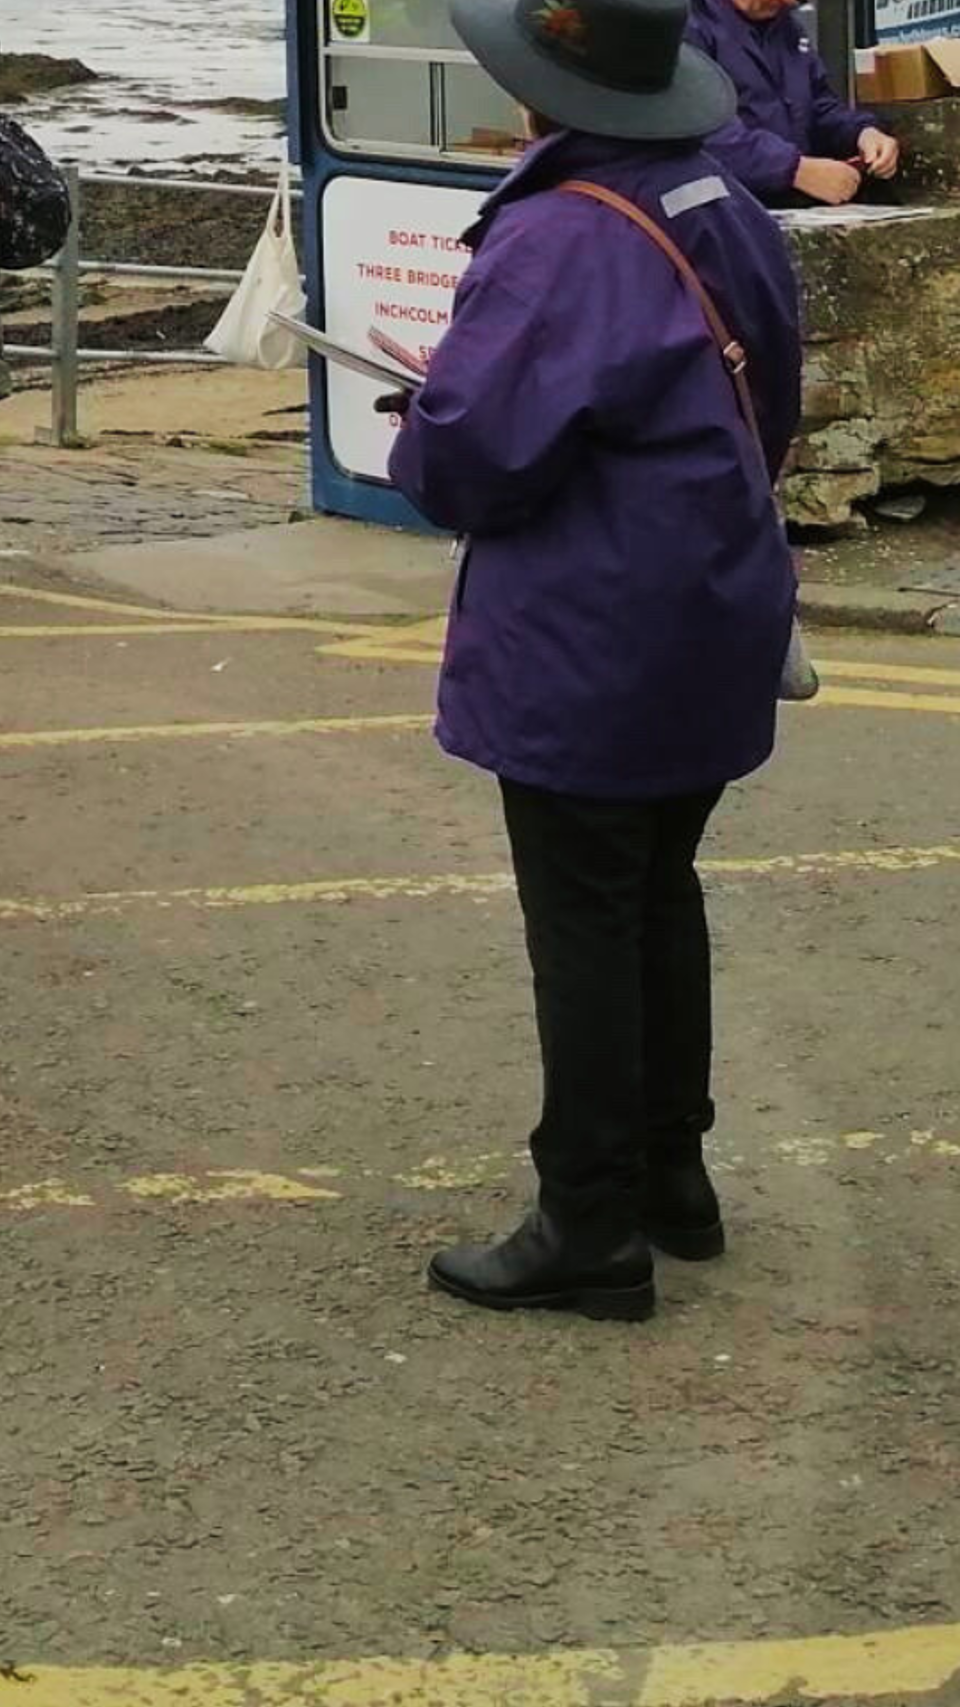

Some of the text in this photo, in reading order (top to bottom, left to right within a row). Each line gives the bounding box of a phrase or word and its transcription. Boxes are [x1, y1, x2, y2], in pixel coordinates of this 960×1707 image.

[388, 230, 426, 247] BOAT
[357, 263, 402, 283] THREE
[375, 301, 449, 324] INCHCOLM
